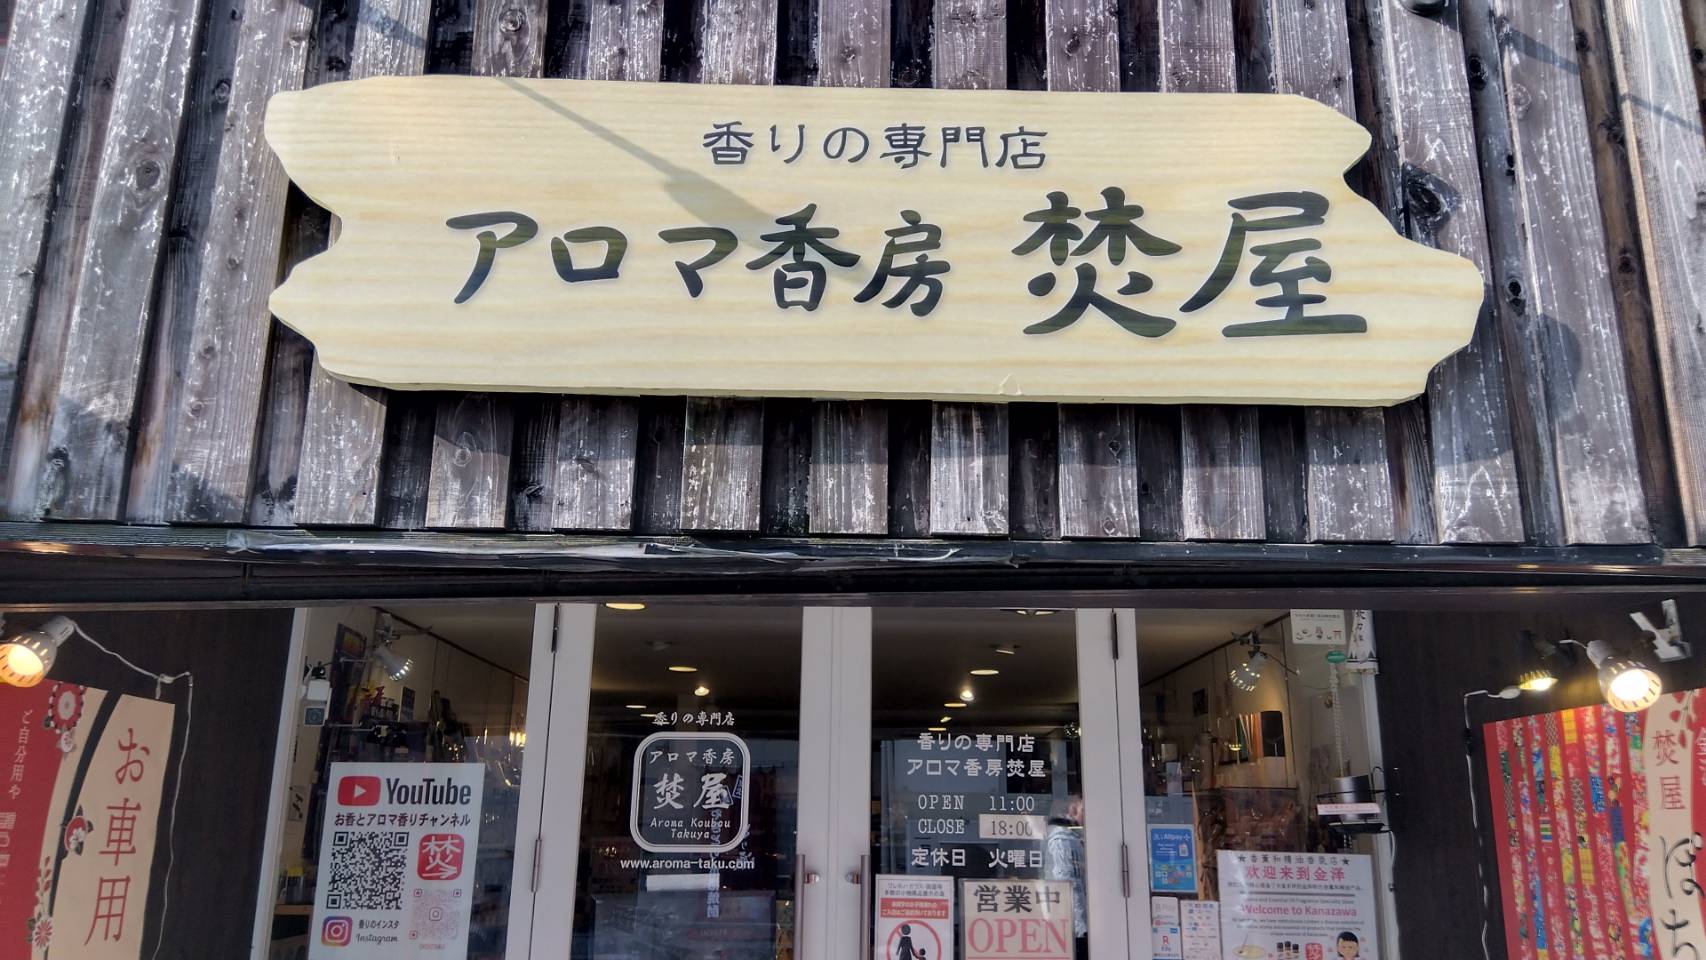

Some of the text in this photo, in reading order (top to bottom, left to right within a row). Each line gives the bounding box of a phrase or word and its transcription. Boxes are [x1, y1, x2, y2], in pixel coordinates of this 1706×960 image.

[703, 121, 1047, 169] 香りの専門店
[446, 186, 1367, 338] アロマ香房 焚屋
[652, 712, 735, 726] 香りの専門店
[917, 732, 1035, 753] 香りの専門店
[650, 748, 735, 765] アロマ香房
[1652, 730, 1686, 810] 焚屋
[386, 777, 472, 805] YouTube
[653, 773, 730, 810] 焚屋
[918, 795, 1035, 812] OPEN 11:00
[334, 813, 471, 827] お香とアロマ香りチャンネル
[650, 817, 731, 828] Aroma Koubou
[918, 819, 1034, 836] CLOSE 18:00
[85, 728, 149, 945] お車用
[671, 829, 710, 840] Takuya
[620, 855, 755, 869] www.aroma-taku.com
[911, 848, 1043, 868] 定休日 火曜日
[974, 885, 1060, 914] 営業中
[1243, 903, 1357, 916] Welcome to Kanazawa
[359, 920, 399, 929] 香りのインスタ
[356, 934, 399, 945] Instagram
[968, 918, 1069, 953] OPEN
